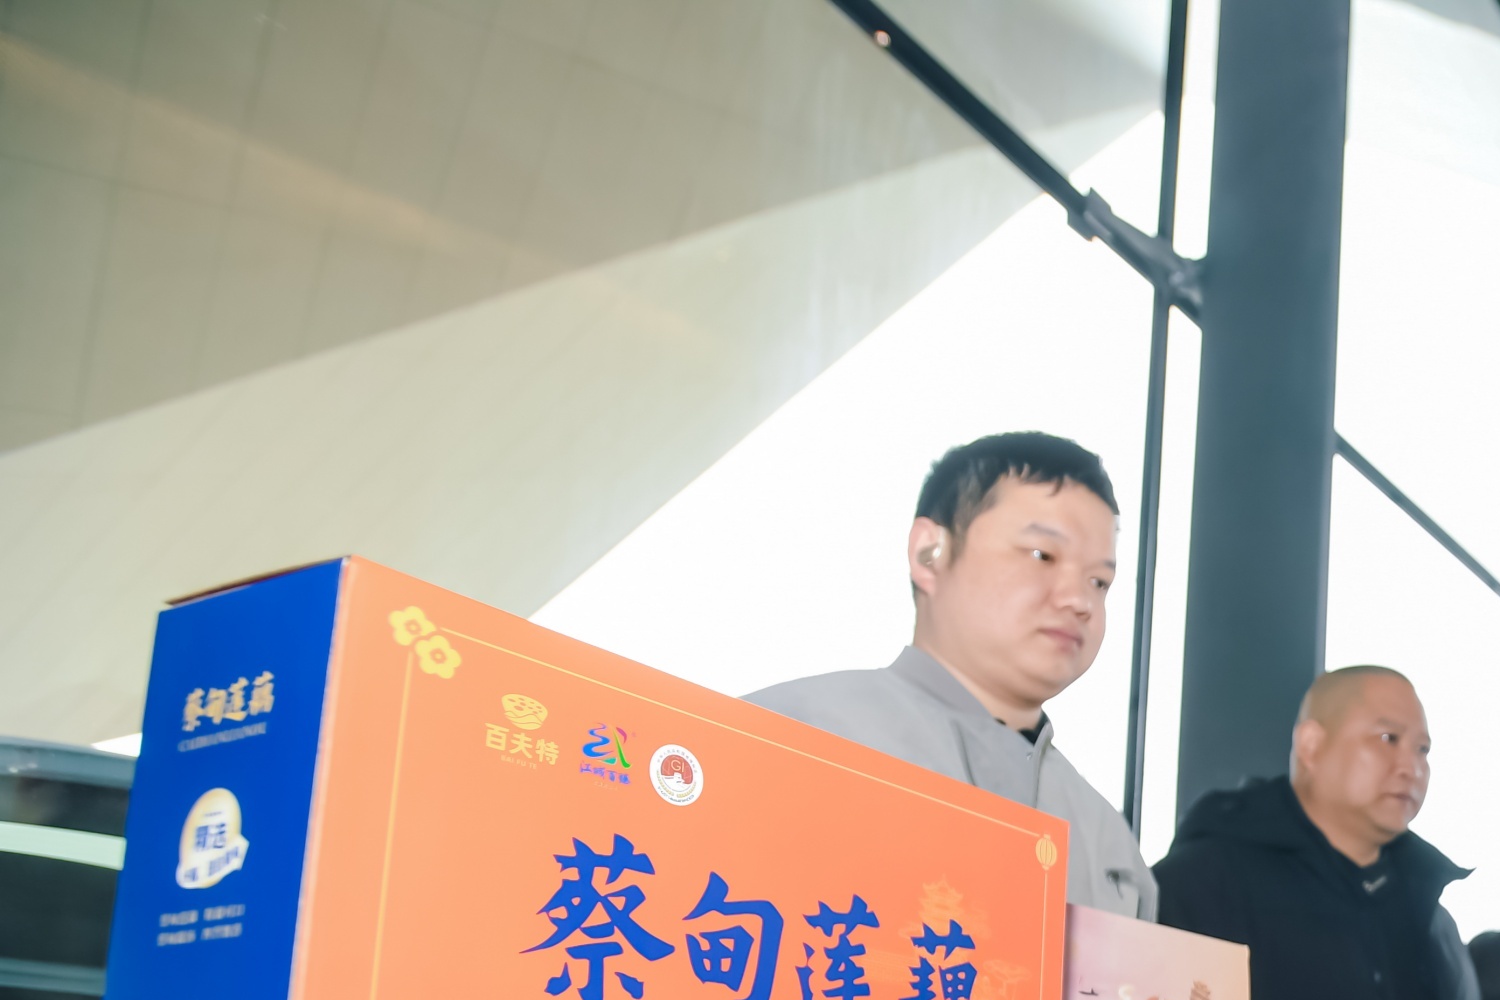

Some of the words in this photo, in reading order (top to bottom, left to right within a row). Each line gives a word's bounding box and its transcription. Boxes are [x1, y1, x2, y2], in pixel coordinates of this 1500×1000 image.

[485, 722, 560, 766] 百夫特
[671, 760, 684, 773] GI
